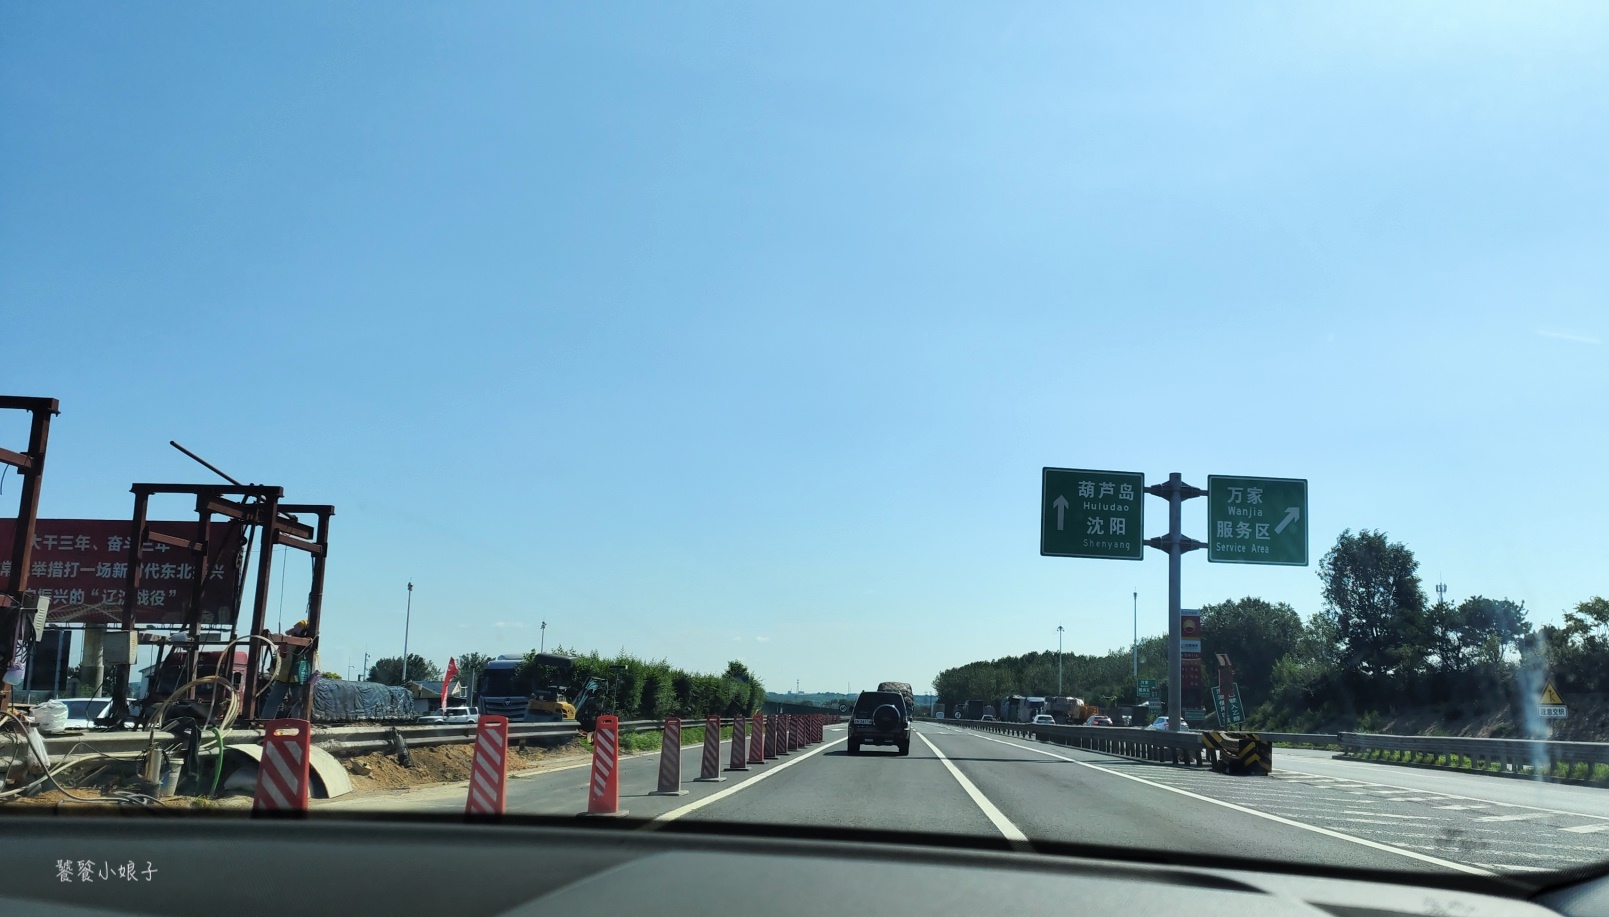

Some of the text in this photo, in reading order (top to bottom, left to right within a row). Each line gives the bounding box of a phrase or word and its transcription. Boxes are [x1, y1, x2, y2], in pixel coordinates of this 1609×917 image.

[1078, 480, 1134, 501] 葫芦岛
[1227, 486, 1263, 505] 万家
[1083, 501, 1129, 511] Huludao
[1228, 506, 1263, 518] Wanjia
[1086, 516, 1126, 535] 沈阳
[1216, 520, 1270, 540] 服务区
[1083, 539, 1130, 551] Shenyang
[1216, 542, 1269, 554] Service Area
